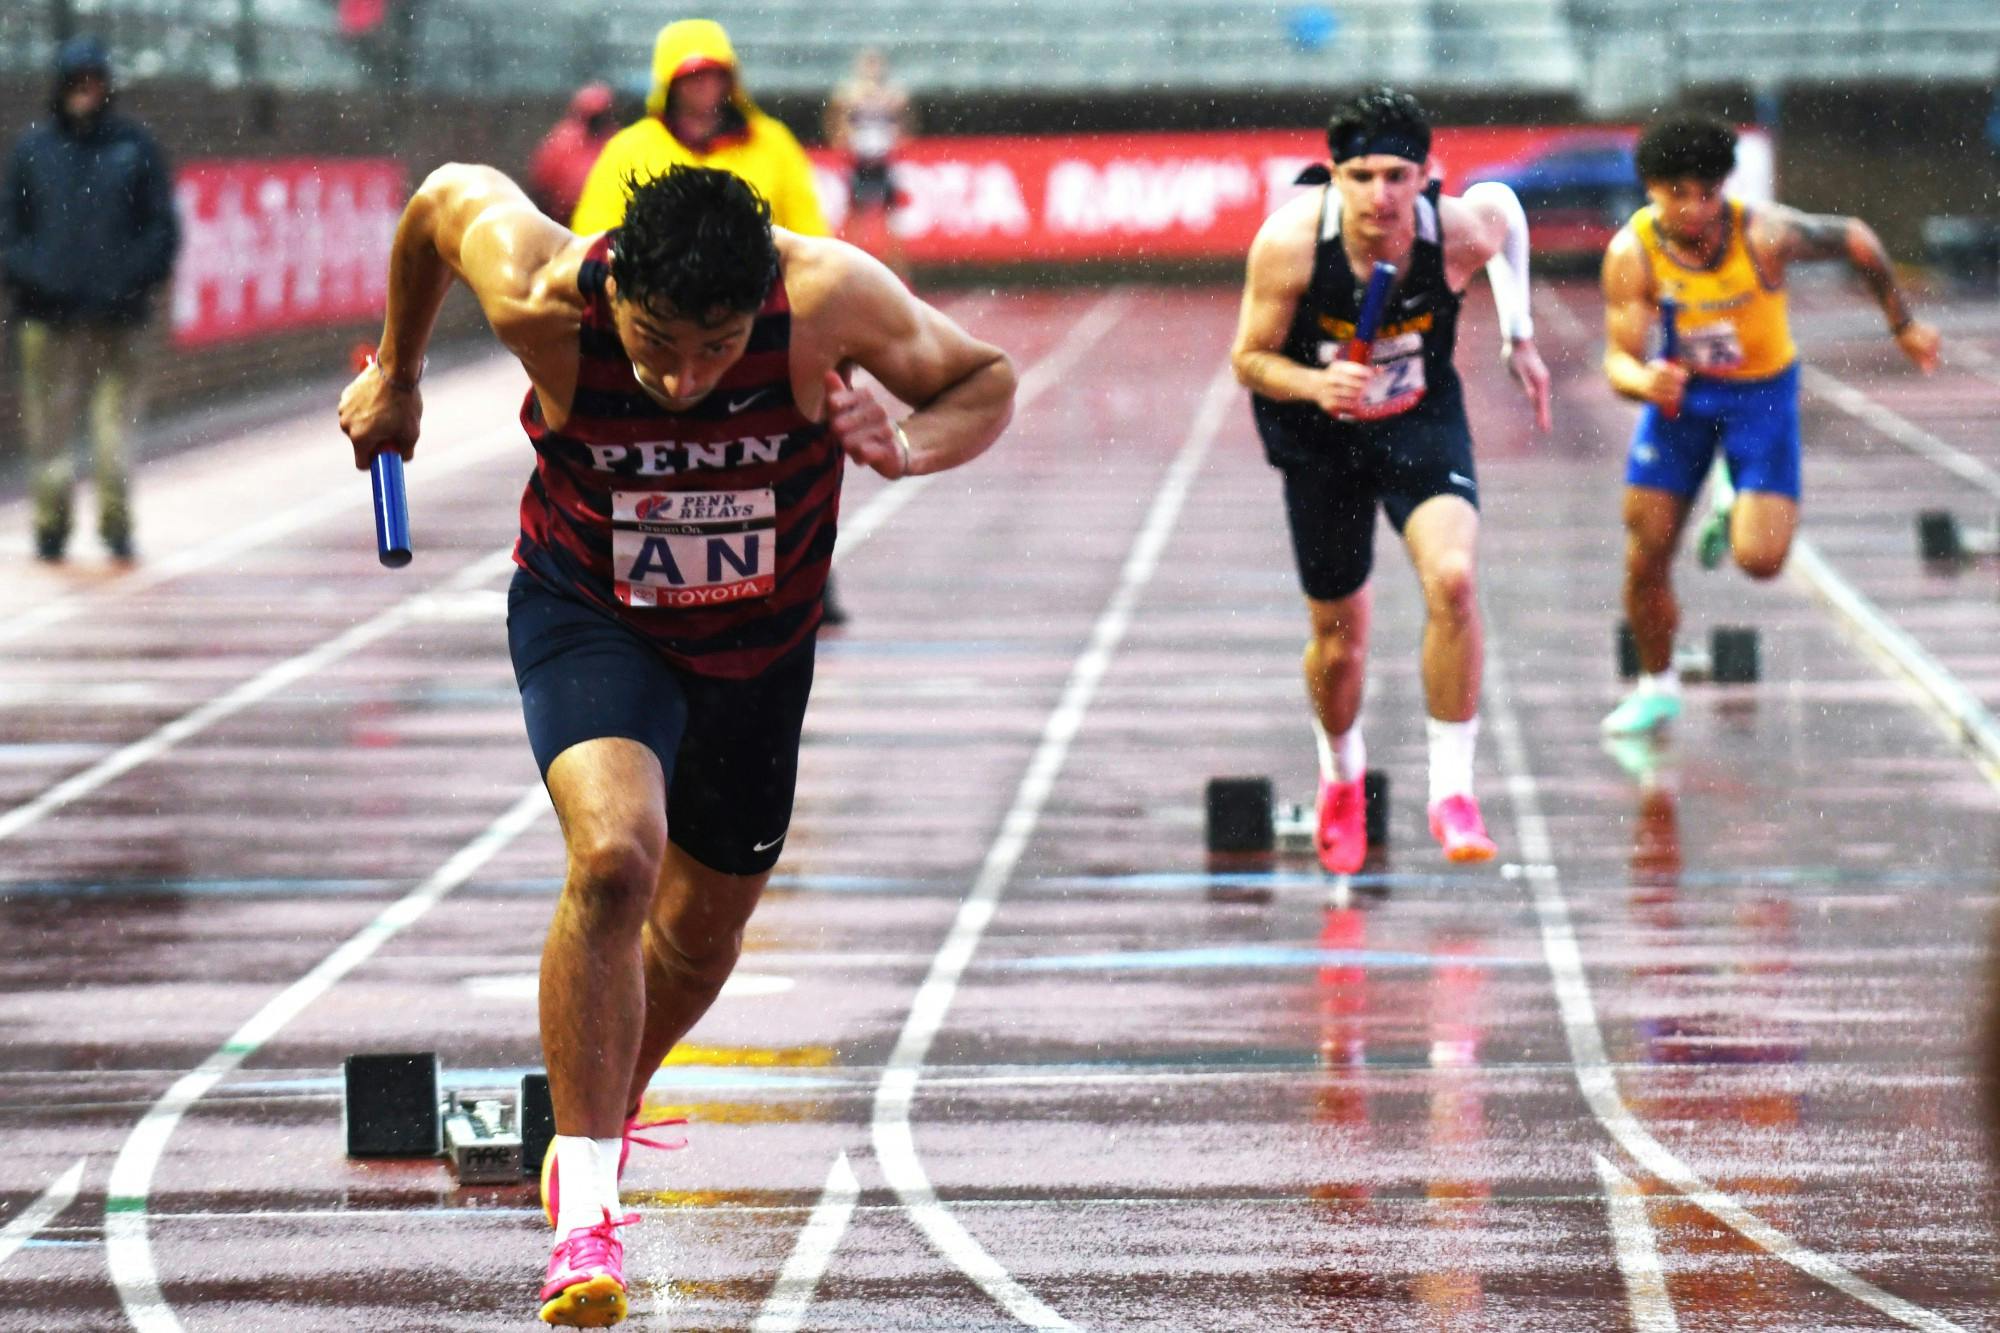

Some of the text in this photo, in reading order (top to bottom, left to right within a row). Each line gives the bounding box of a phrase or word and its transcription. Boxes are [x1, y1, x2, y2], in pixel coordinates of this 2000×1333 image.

[585, 434, 789, 476] PENN
[681, 494, 736, 507] PENN
[679, 505, 754, 519] RELAYS
[664, 581, 758, 604] TOYOTA
